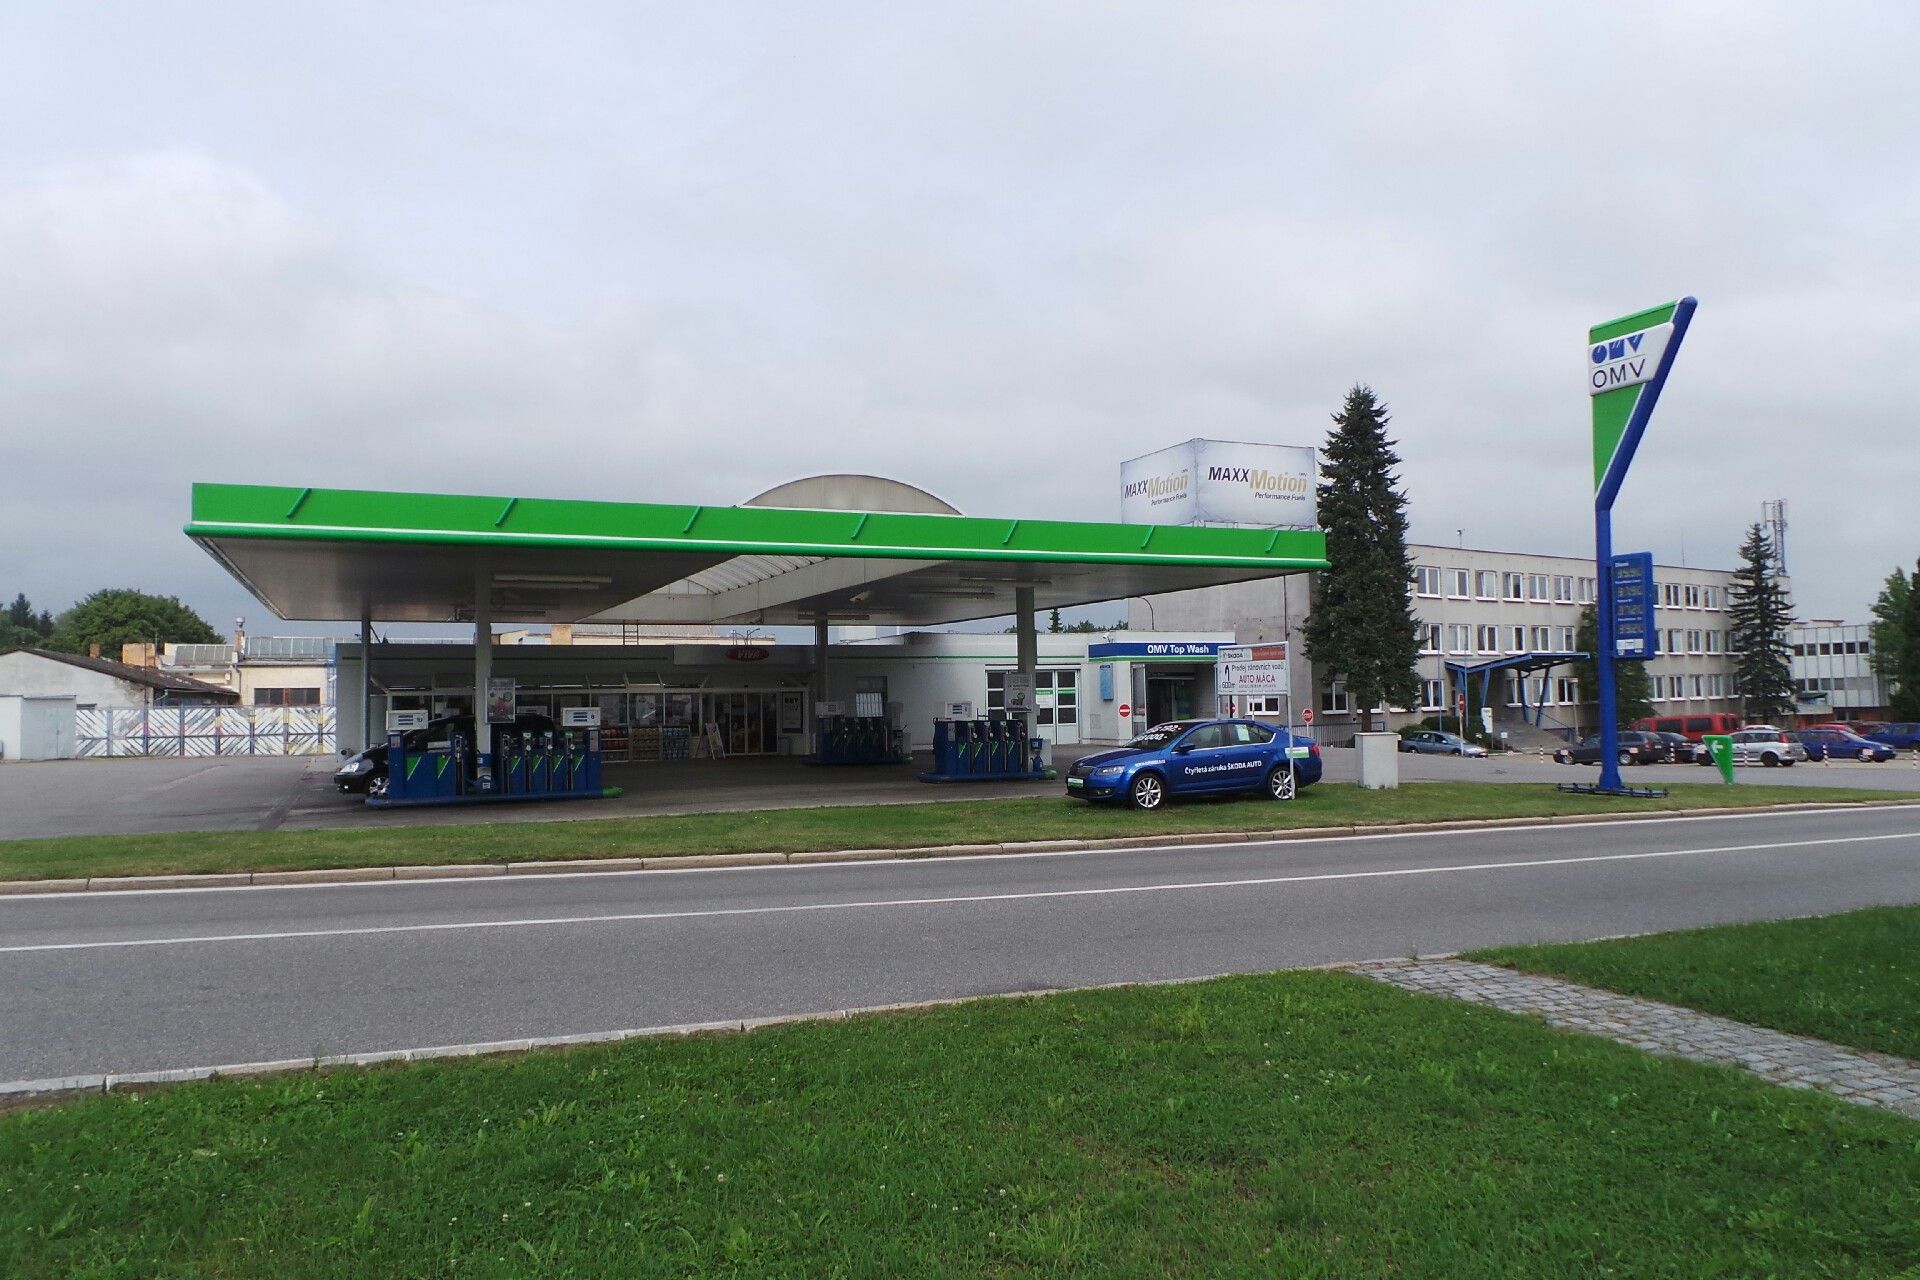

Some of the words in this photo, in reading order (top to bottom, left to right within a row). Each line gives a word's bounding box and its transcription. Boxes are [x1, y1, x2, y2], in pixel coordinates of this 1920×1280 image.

[1593, 358, 1645, 388] OMV
[1147, 645, 1168, 654] OMV
[1170, 645, 1185, 655] Top
[1187, 645, 1209, 654] Wash
[1239, 675, 1254, 684] AUTO
[1227, 762, 1246, 770] ŠKODA
[1247, 760, 1262, 768] AUTO
